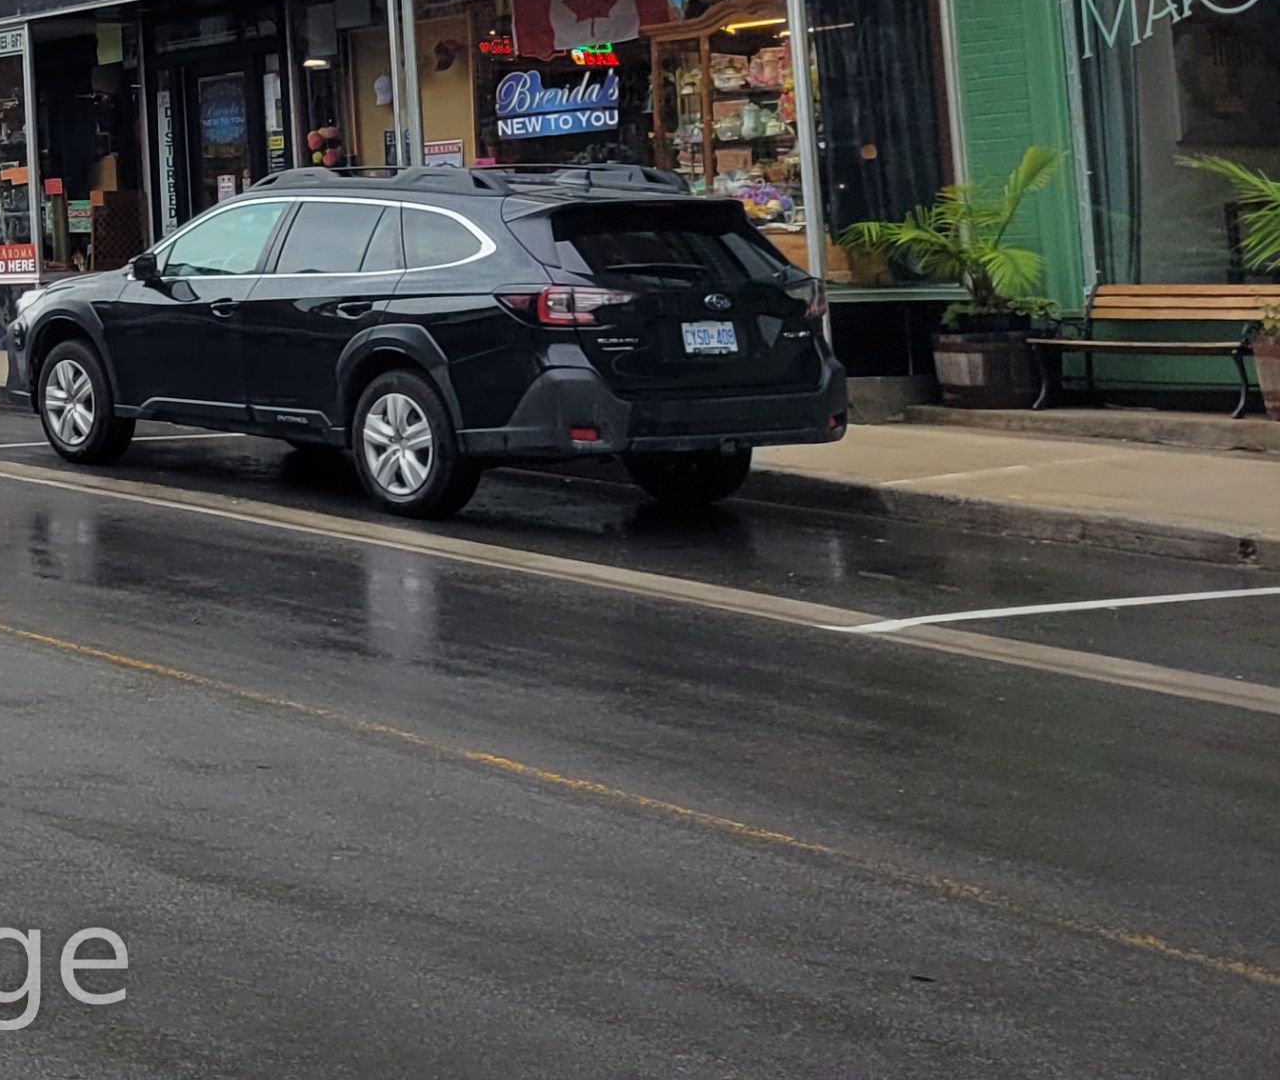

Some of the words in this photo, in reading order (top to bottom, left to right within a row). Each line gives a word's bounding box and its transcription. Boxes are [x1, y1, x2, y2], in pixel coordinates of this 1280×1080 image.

[495, 68, 619, 114] Brenda's
[497, 116, 542, 137] NEW
[576, 110, 619, 128] YOU
[1, 247, 33, 260] AROMA
[8, 259, 35, 272] HERE
